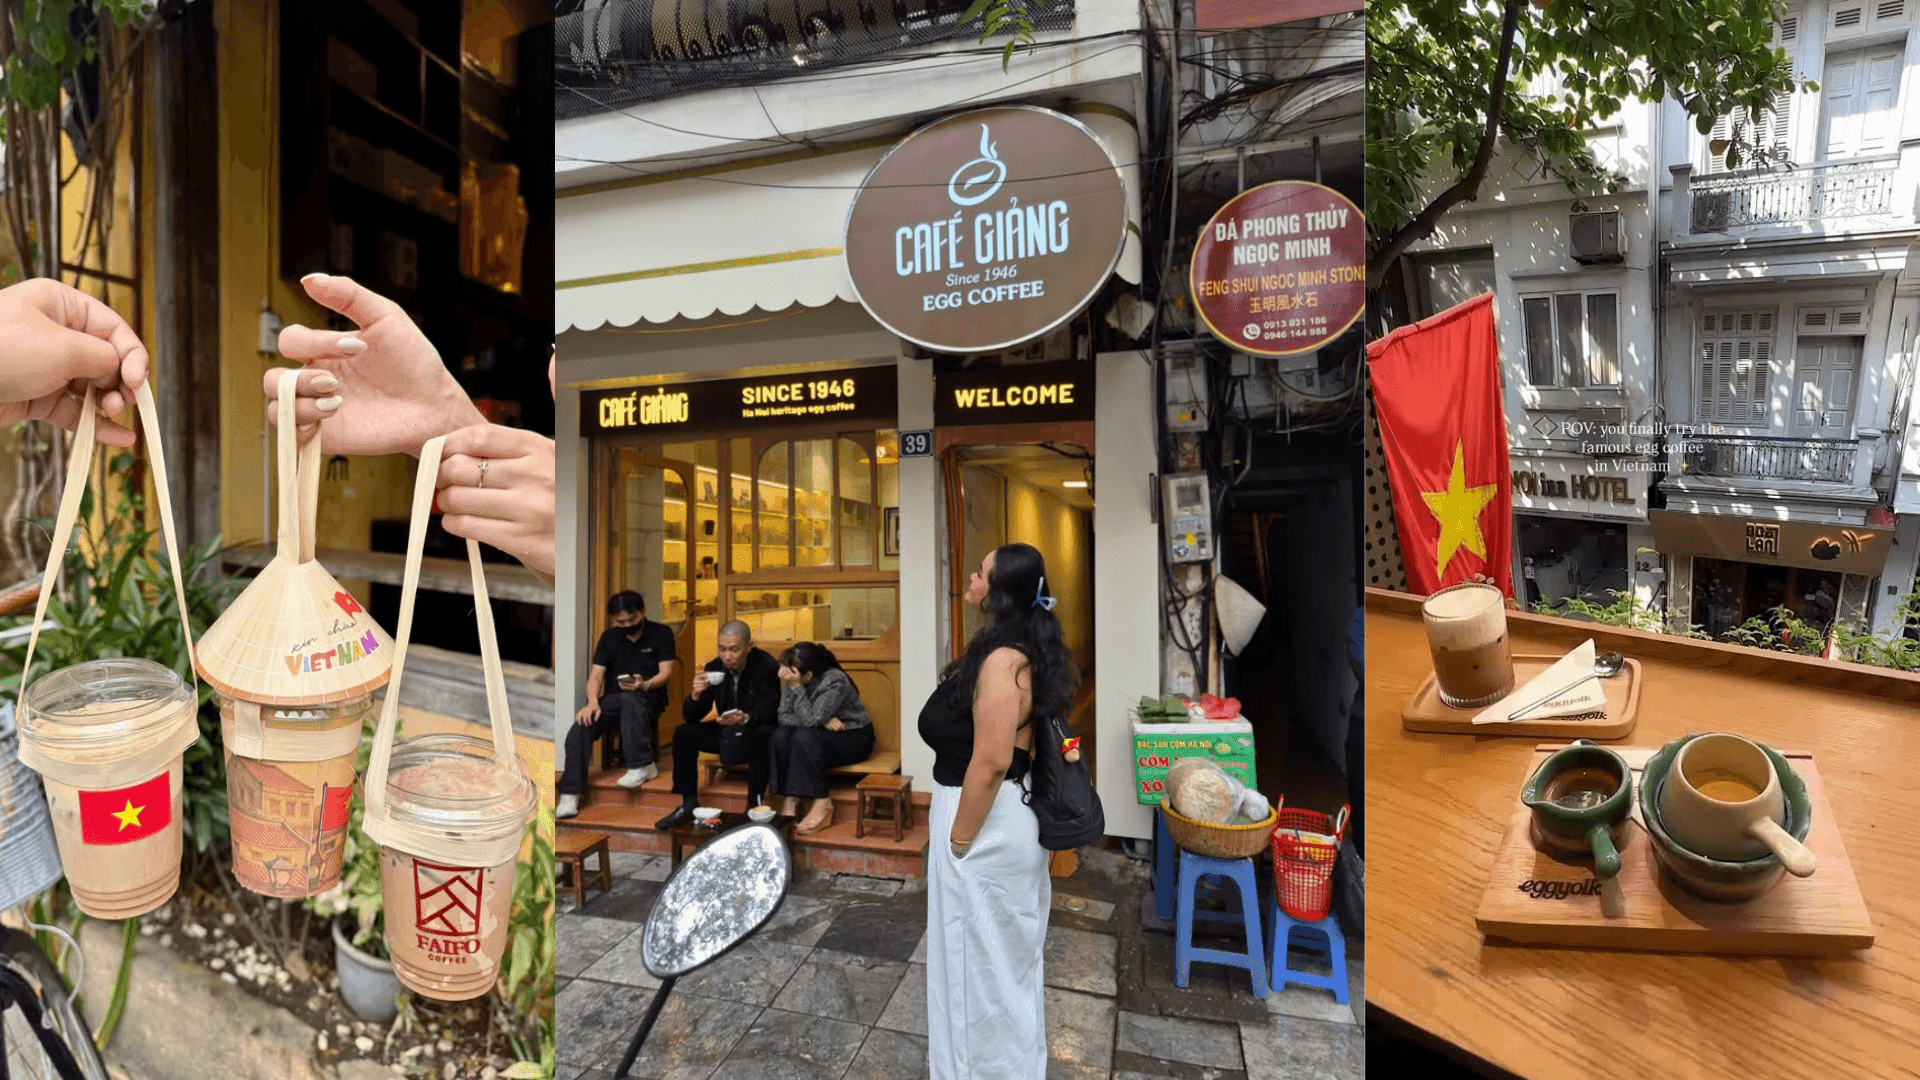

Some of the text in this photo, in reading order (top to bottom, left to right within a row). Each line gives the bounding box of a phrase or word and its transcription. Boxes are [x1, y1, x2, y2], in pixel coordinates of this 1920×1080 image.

[1215, 203, 1348, 241] ĐÁ PHONG THỦY
[895, 196, 1070, 276] CAFÉ GIẢNG
[1233, 237, 1331, 267] NGỌC MINH
[945, 264, 1018, 287] Since 1946
[1199, 280, 1229, 297] FENG
[1232, 277, 1259, 294] SHUI
[1261, 272, 1295, 291] NGOC
[1298, 270, 1327, 288] MINH
[923, 280, 1044, 312] EGG COFFEE
[742, 379, 855, 404] SINCE 1946
[954, 383, 1075, 408] WELCOME
[600, 387, 689, 427] CAFÉ GIẢNG
[905, 434, 927, 454] 39
[1540, 472, 1568, 498] inn
[1571, 474, 1636, 504] HOTEL
[285, 629, 379, 676] VIETNAM
[1141, 777, 1166, 793] XÔ
[1517, 878, 1603, 900] eggyolk
[416, 934, 481, 955] FAIFO
[428, 954, 467, 964] COFFEE
